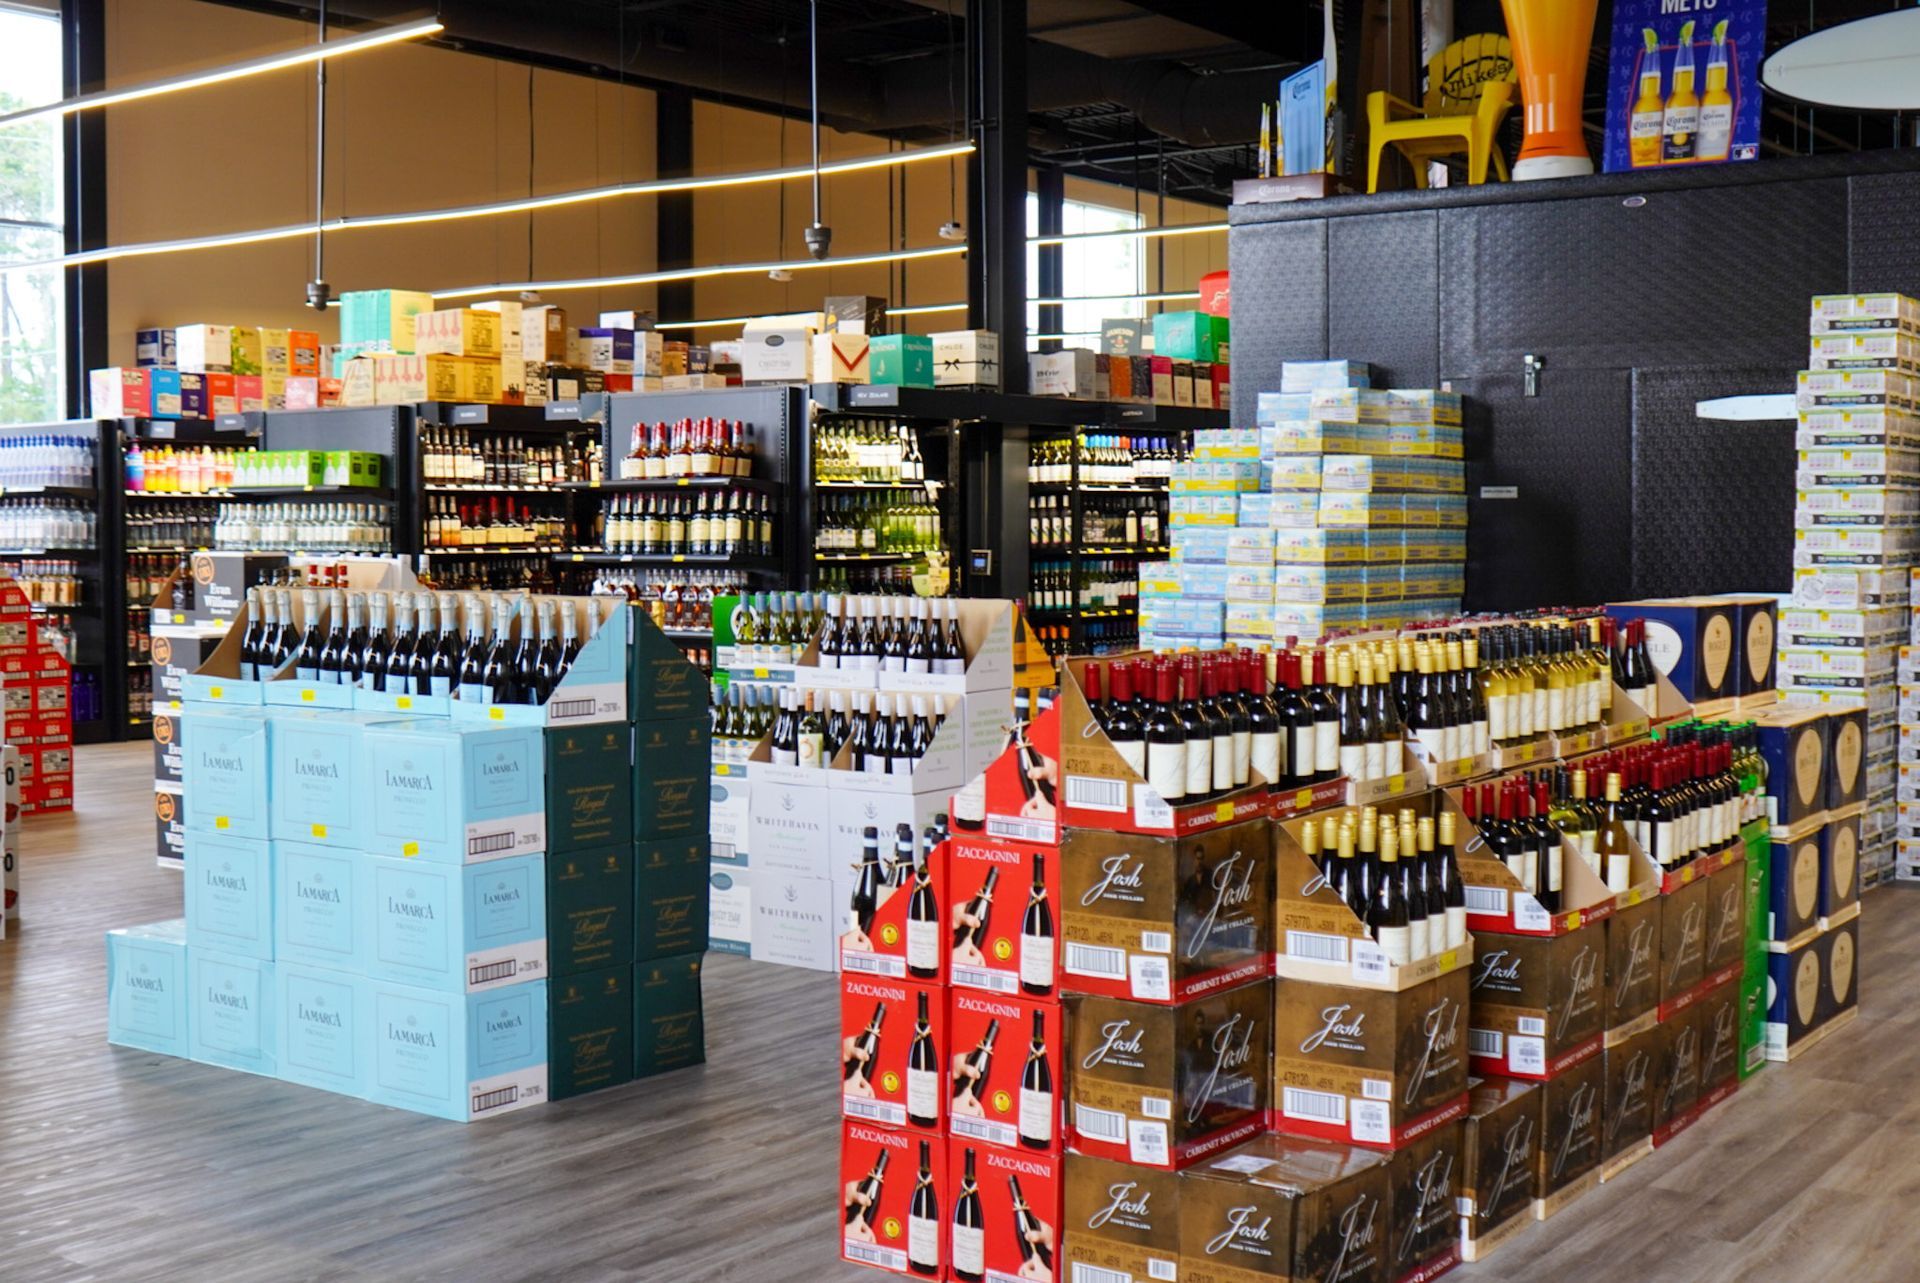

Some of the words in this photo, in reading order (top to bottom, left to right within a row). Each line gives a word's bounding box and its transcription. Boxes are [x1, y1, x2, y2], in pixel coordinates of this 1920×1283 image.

[1666, 116, 1696, 126] Corona
[210, 583, 232, 596] Evan
[1650, 643, 1669, 653] GLE
[656, 666, 690, 692] Royal
[573, 791, 609, 821] Royal
[658, 785, 692, 812] Royal
[756, 816, 819, 831] WHITEHAVEN
[957, 845, 1021, 864] ZACCAGNINI
[1082, 853, 1144, 906] Josh
[656, 903, 690, 930] Royal
[760, 906, 823, 922] WHITEHAVEN
[1187, 850, 1255, 959] Josh
[574, 914, 610, 944] Royal
[1669, 902, 1704, 985] Josh
[1186, 971, 1221, 994] CABERNET
[1221, 964, 1256, 986] SAUVIGNON
[1472, 950, 1522, 990] Josh
[1616, 919, 1654, 1008] Josh
[847, 982, 906, 1001] ZACCAGNINI
[958, 997, 1021, 1019] ZACCAGNINI
[1556, 945, 1597, 1040] Josh
[1083, 1019, 1144, 1069] Josh
[1301, 1004, 1365, 1053] Josh
[1188, 1012, 1254, 1123] Josh
[1406, 997, 1459, 1104] Josh
[1609, 1050, 1649, 1139] Josh
[850, 1127, 909, 1149] ZACCAGNINI
[1186, 1138, 1219, 1158] CABERNET
[1220, 1123, 1255, 1145] SAUVIGNON
[1404, 1119, 1432, 1139] CABERNET
[1553, 1082, 1596, 1178] Josh
[987, 1153, 1051, 1177] ZACCAGNINI
[1480, 1115, 1534, 1218] Josh
[1088, 1182, 1151, 1229] Josh
[1398, 1150, 1454, 1261] Josh
[1206, 1206, 1272, 1254] Josh
[1325, 1194, 1378, 1283] Josh
